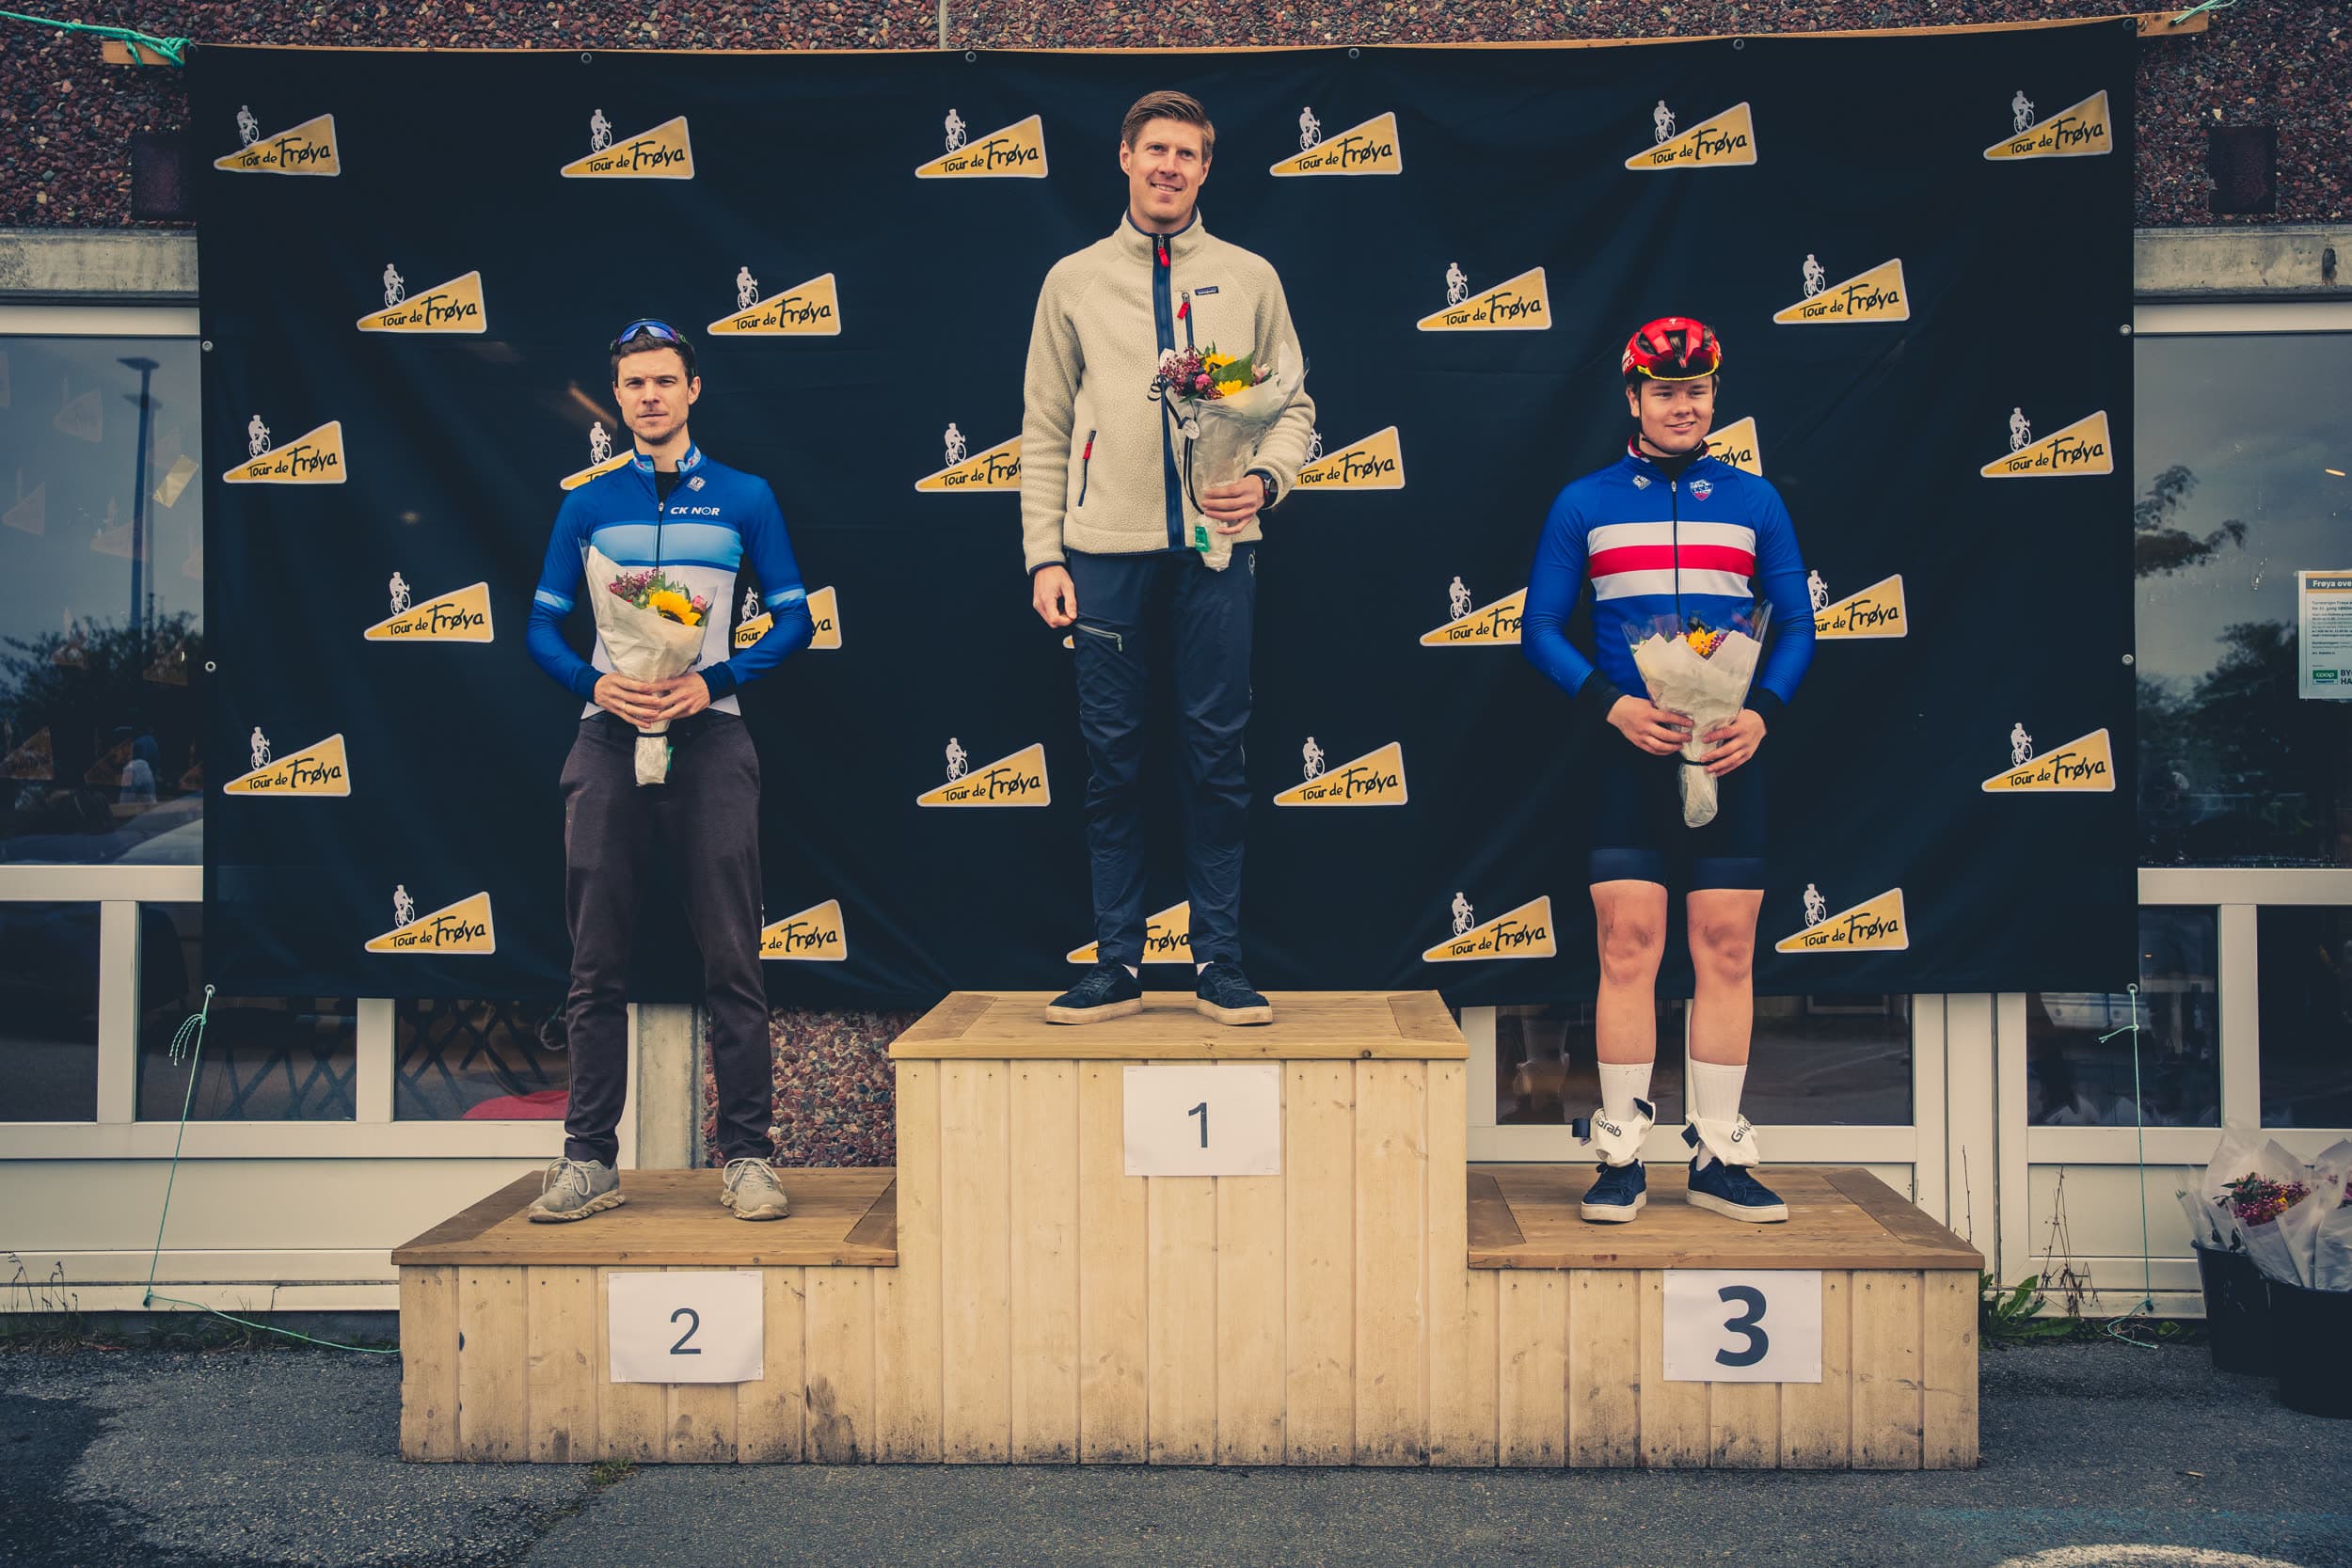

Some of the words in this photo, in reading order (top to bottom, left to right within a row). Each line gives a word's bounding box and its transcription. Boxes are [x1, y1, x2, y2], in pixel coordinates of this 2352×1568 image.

[262, 150, 278, 163] de
[275, 137, 331, 167] Frøya
[1650, 149, 1677, 164] Tour
[1679, 144, 1692, 157] de
[1690, 129, 1747, 160] Frøya
[2009, 138, 2035, 154] Tour
[2039, 135, 2053, 147] de
[2050, 118, 2104, 150] Frøya
[586, 158, 613, 172] Tour
[616, 154, 630, 167] de
[628, 141, 685, 170] Frøya
[941, 157, 968, 172] Tour
[971, 153, 985, 166] de
[982, 139, 1039, 169] Frøya
[1295, 155, 1323, 170] Tour
[1326, 151, 1340, 165] de
[1337, 136, 1392, 167] Frøya
[379, 312, 407, 326] Tour
[409, 309, 424, 323] de
[422, 295, 477, 325] Frøya
[733, 315, 760, 329] Tour
[763, 311, 777, 325] de
[774, 297, 831, 328] Frøya
[1442, 310, 1470, 325] Tour
[1473, 308, 1488, 321] de
[1486, 293, 1542, 324] Frøya
[1799, 303, 1827, 318] Tour
[1830, 299, 1845, 312] de
[1842, 284, 1899, 315] Frøya
[247, 463, 272, 478] Tour
[275, 460, 287, 473] de
[284, 446, 337, 476] Frøya
[941, 471, 968, 486] Tour
[971, 468, 984, 481] de
[982, 453, 1021, 483] Frø
[1297, 469, 1325, 484] Tour
[1327, 467, 1340, 480] de
[1339, 451, 1394, 483] Frøya
[2006, 456, 2033, 471] Tour
[2035, 453, 2049, 467] de
[2047, 436, 2104, 468] Frøya
[670, 506, 689, 515] CK
[691, 506, 721, 515] NOR
[387, 621, 412, 635] Tour
[415, 617, 428, 630] de
[425, 604, 485, 633] Frøya
[1445, 626, 1473, 640] Tour
[1476, 622, 1489, 635] de
[1487, 607, 1521, 637] Frø
[1833, 616, 1846, 628] de
[1845, 600, 1899, 631] Frøya
[736, 627, 760, 642] Tour
[246, 775, 273, 789] Tour
[275, 771, 288, 784] de
[286, 758, 342, 788] Frøya
[943, 786, 970, 801] Tour
[972, 784, 986, 797] de
[984, 768, 1041, 800] Frøya
[1299, 785, 1327, 800] Tour
[1329, 783, 1343, 796] de
[1341, 768, 1398, 799] Frøya
[2008, 771, 2034, 786] Tour
[2037, 768, 2050, 781] de
[2047, 753, 2106, 784] Frøya
[390, 933, 418, 947] Tour
[420, 929, 434, 942] de
[432, 916, 485, 946] Frøya
[769, 936, 782, 949] de
[781, 922, 837, 952] Frøya
[1448, 941, 1476, 956] Tour
[1478, 937, 1493, 950] de
[1491, 921, 1546, 952] Frøya
[1801, 932, 1829, 946] Tour
[1832, 928, 1847, 942] de
[1844, 913, 1899, 943] Frøya
[1187, 1101, 1209, 1148] 1
[669, 1307, 702, 1355] 2
[1715, 1285, 1770, 1367] 3
